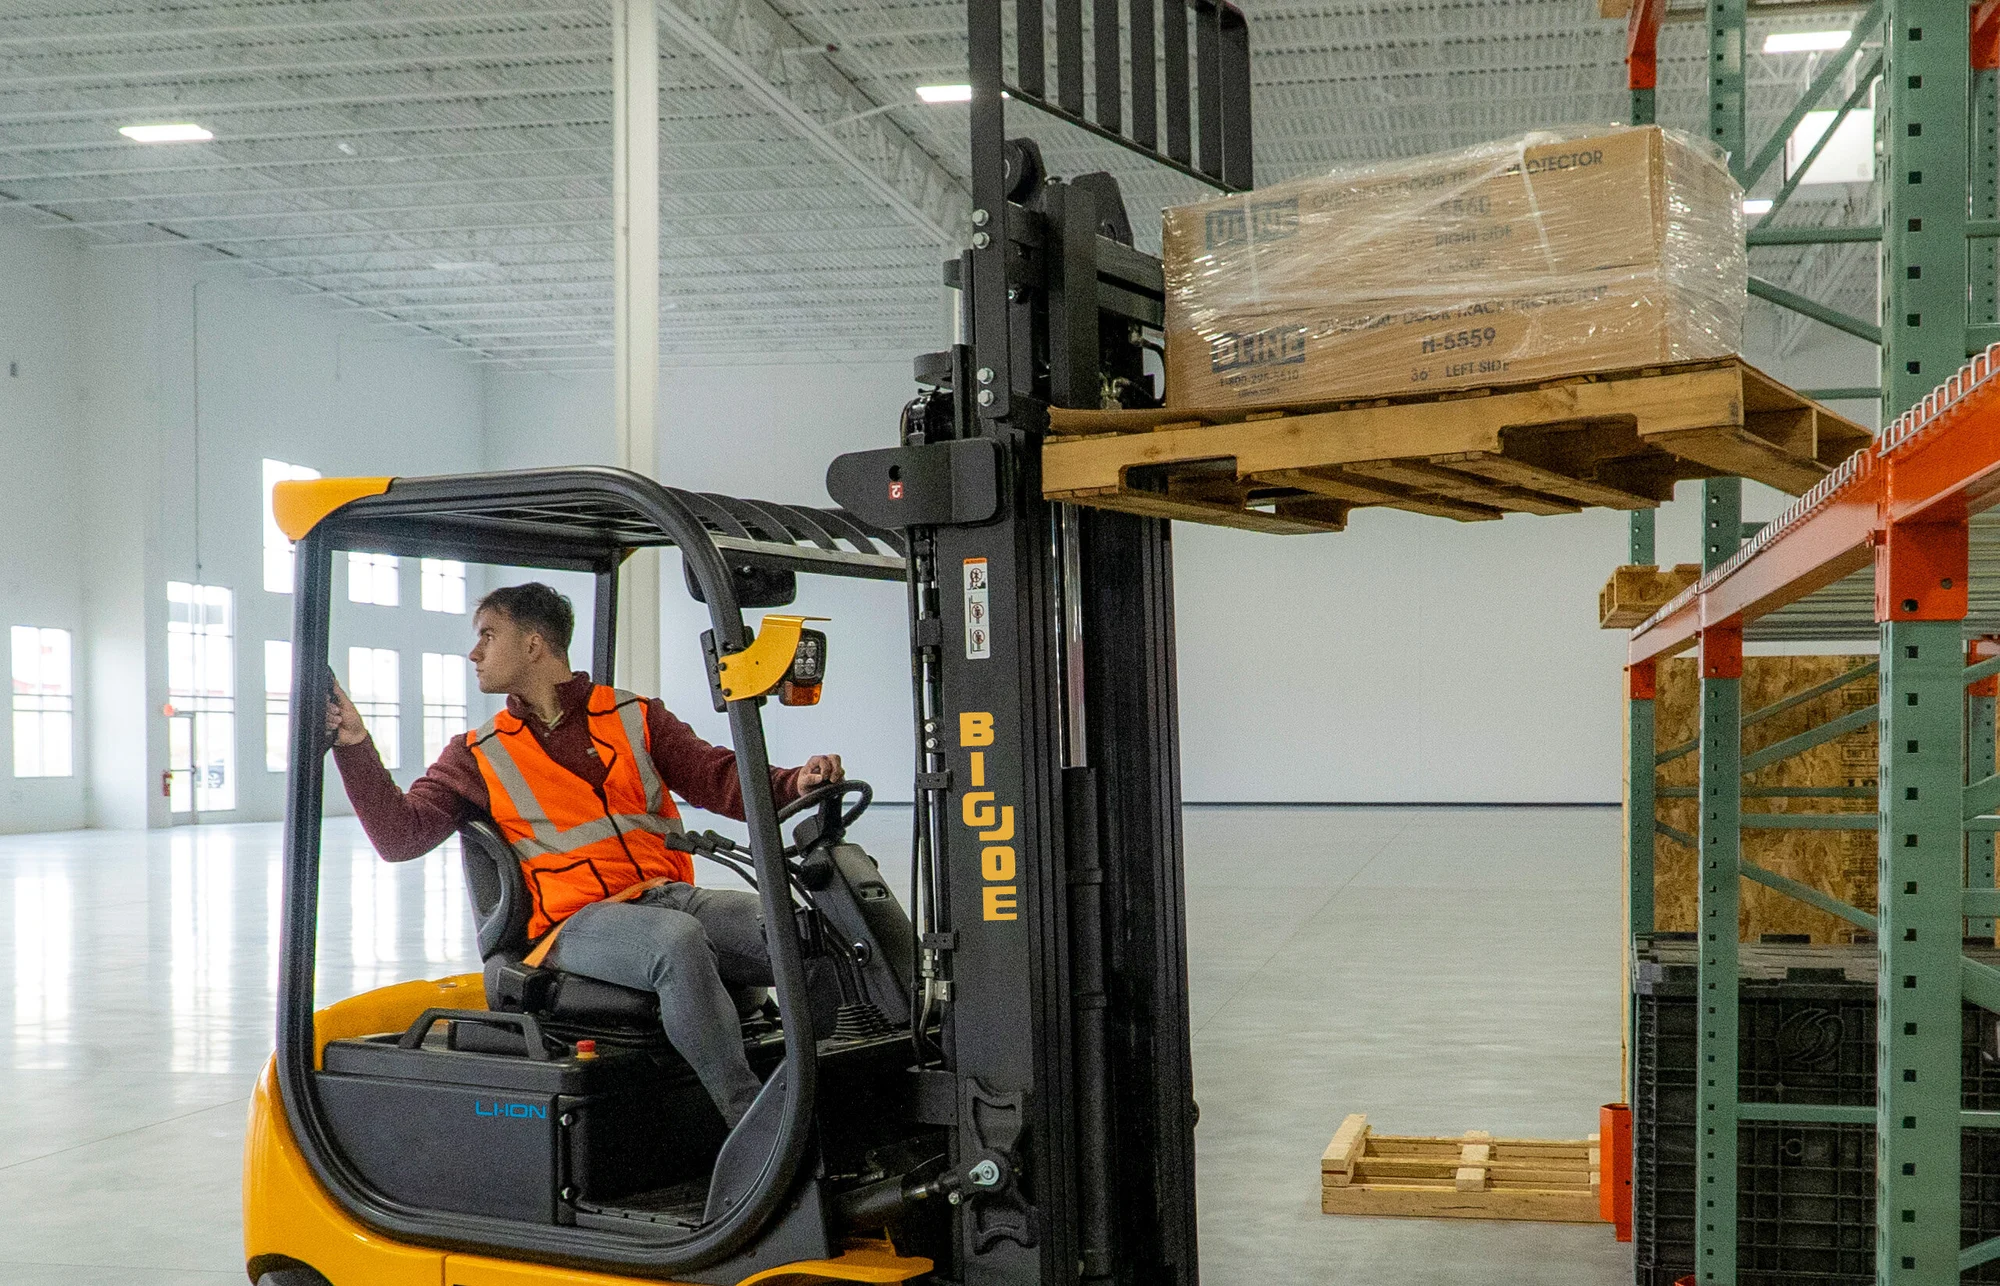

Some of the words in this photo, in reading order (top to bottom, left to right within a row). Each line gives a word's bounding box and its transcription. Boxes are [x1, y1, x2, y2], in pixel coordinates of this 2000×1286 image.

[1507, 150, 1603, 174] OTECTOR
[1422, 327, 1496, 354] M-5559
[1446, 362, 1475, 377] LEFT
[1479, 360, 1510, 373] SIDE
[960, 711, 996, 827] BIG
[979, 806, 1018, 921] JOE
